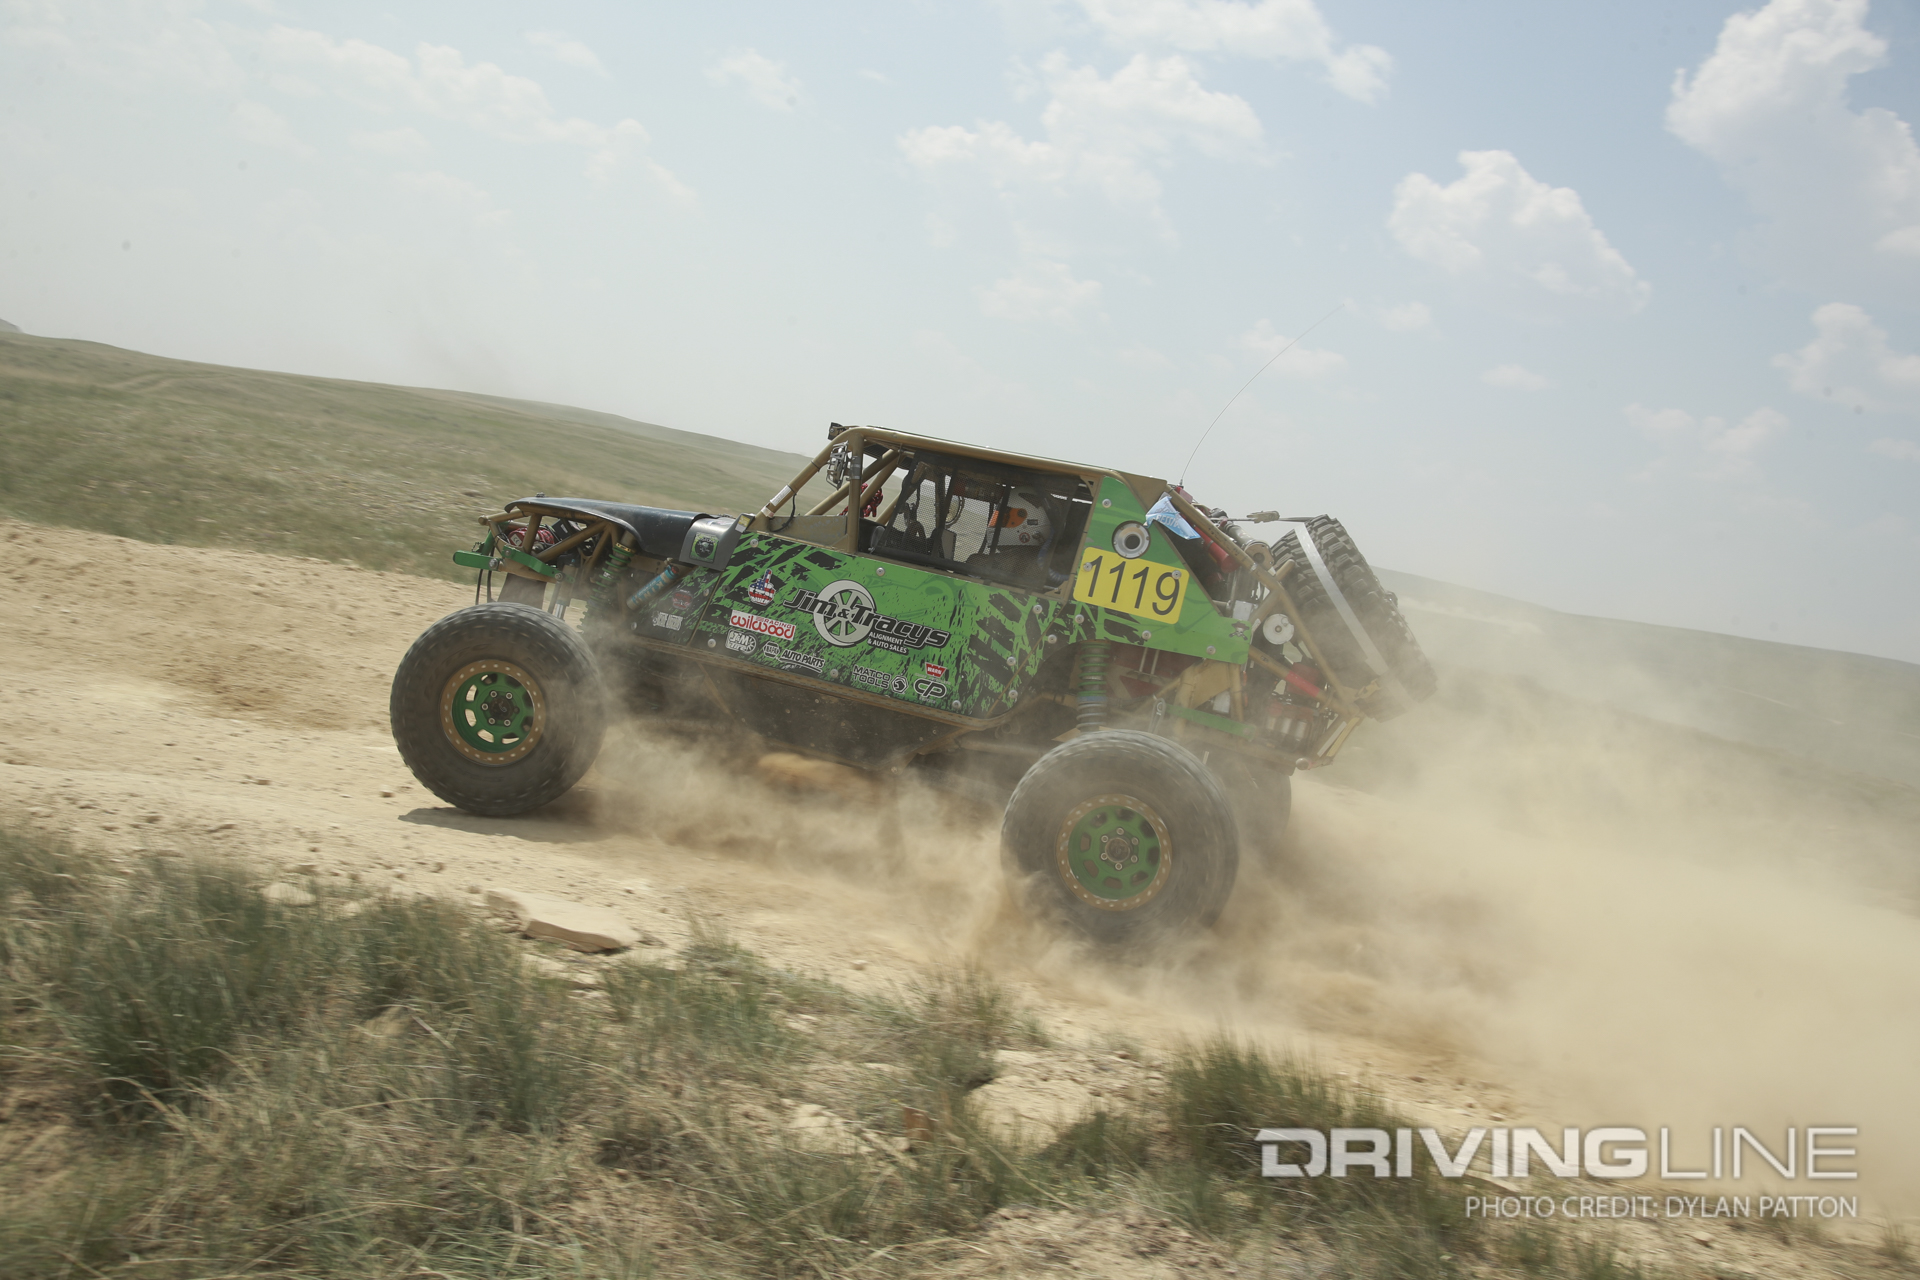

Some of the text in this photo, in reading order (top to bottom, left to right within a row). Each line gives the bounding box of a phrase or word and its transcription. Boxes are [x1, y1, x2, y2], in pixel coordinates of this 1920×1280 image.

[1085, 555, 1180, 616] 1119
[730, 615, 796, 639] wilwood
[763, 618, 792, 629] RACING
[783, 589, 950, 648] Jim & Tracys
[868, 632, 904, 645] ALIGNMENT
[873, 640, 889, 649] AUTO
[889, 643, 907, 654] SALES
[781, 650, 802, 661] AUTO
[802, 654, 825, 669] PARTS
[853, 665, 891, 681] MATCO
[927, 666, 943, 675] WARN
[852, 672, 890, 690] TOOLS
[914, 678, 947, 698] CP
